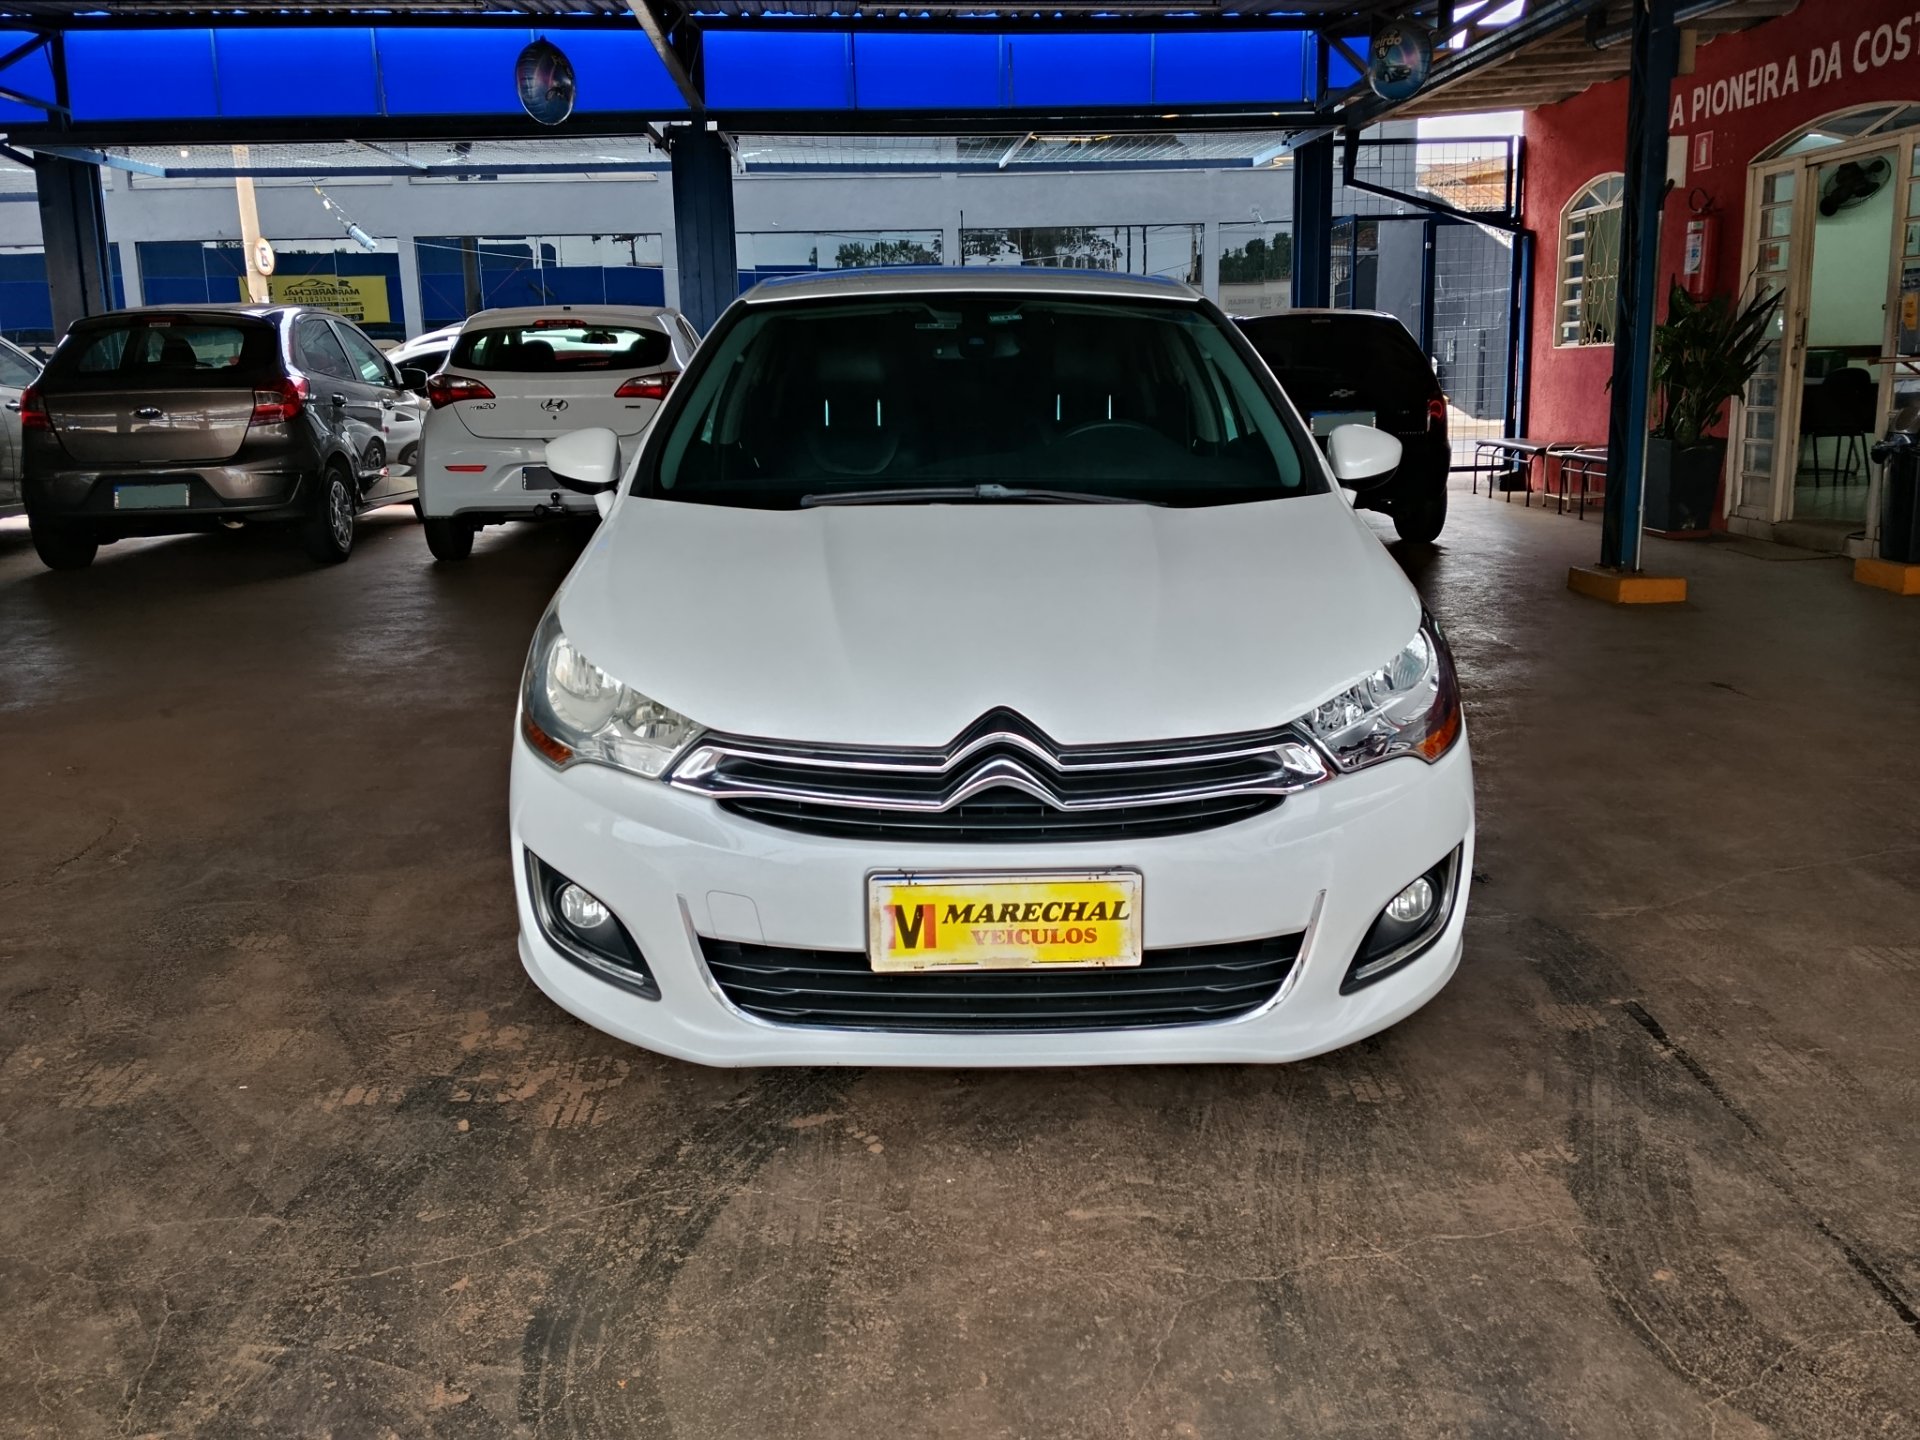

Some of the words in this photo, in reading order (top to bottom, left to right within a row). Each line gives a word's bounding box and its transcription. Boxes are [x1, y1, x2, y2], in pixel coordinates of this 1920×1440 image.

[1669, 94, 1684, 129] A
[1691, 55, 1799, 123] PIONEIRA
[1808, 41, 1843, 89] DA
[942, 901, 1130, 924] MARECHAL
